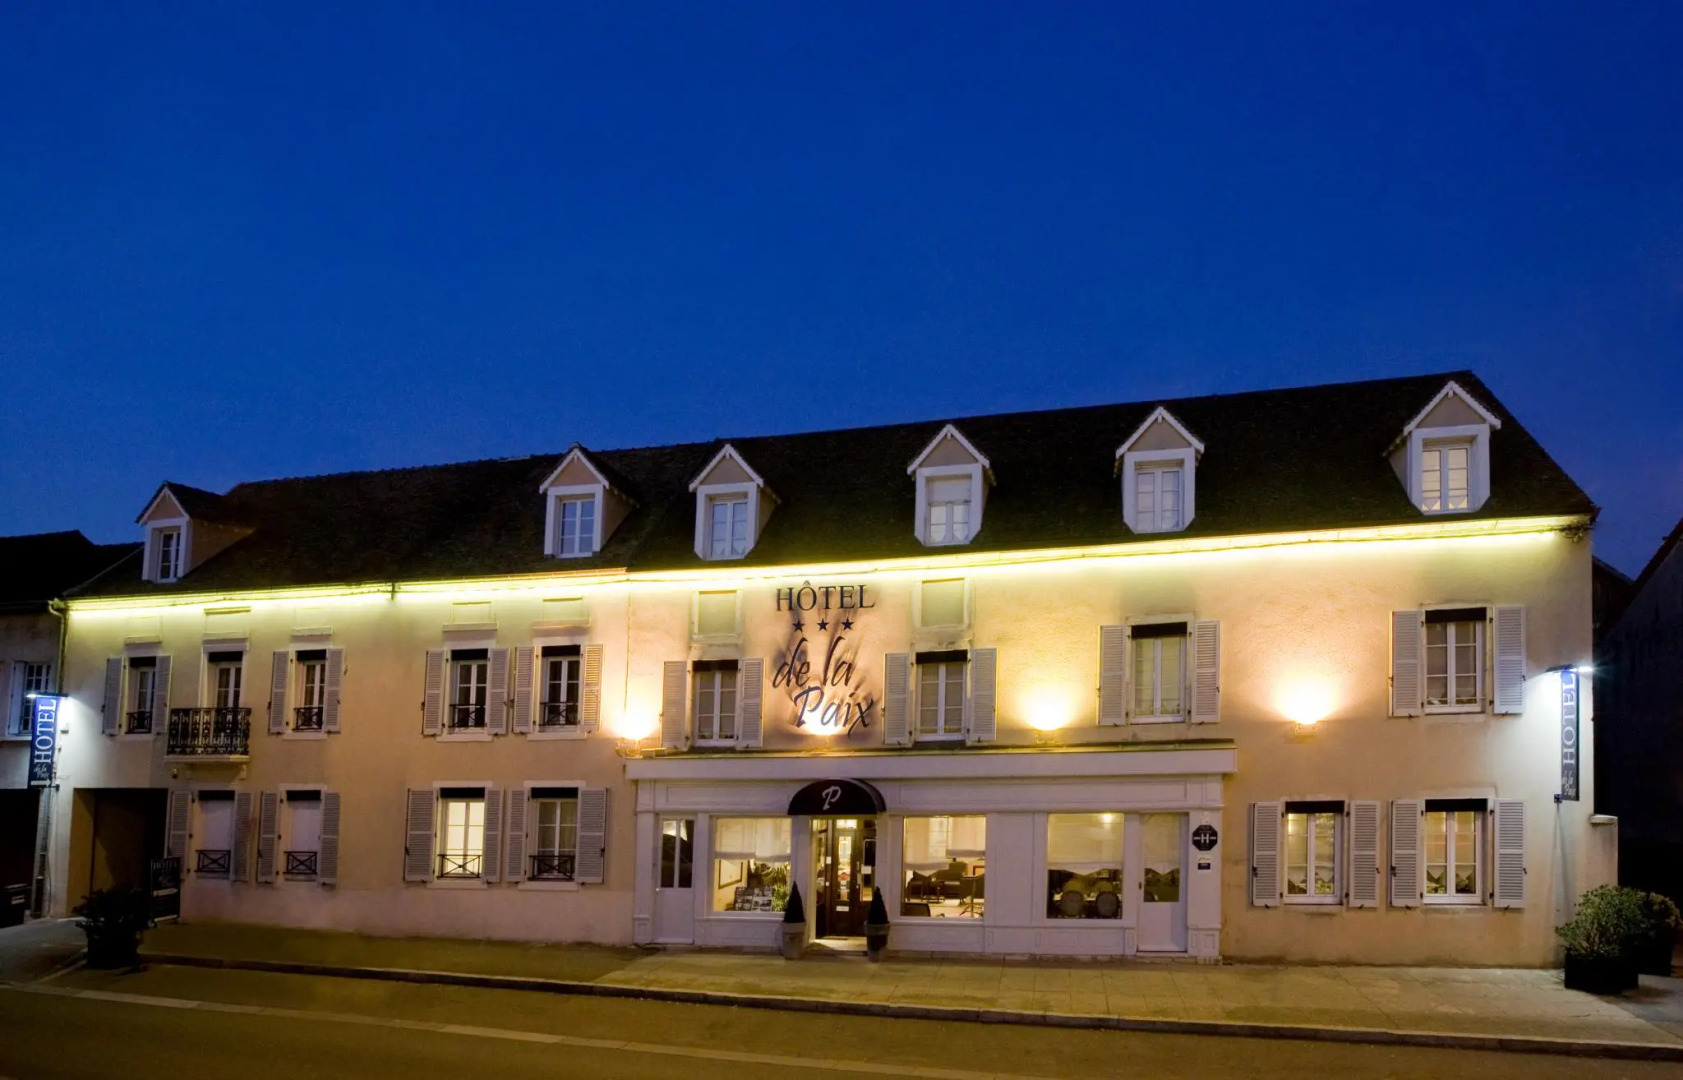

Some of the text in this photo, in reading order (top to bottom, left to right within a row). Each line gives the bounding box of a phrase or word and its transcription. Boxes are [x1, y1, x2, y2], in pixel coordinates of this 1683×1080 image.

[776, 580, 875, 612] HÔTEL
[772, 635, 853, 689] de la
[34, 699, 56, 763] HOTEL
[793, 685, 874, 739] Paix
[1562, 673, 1576, 765] HOTEL
[822, 785, 842, 811] P
[1201, 833, 1209, 844] H
